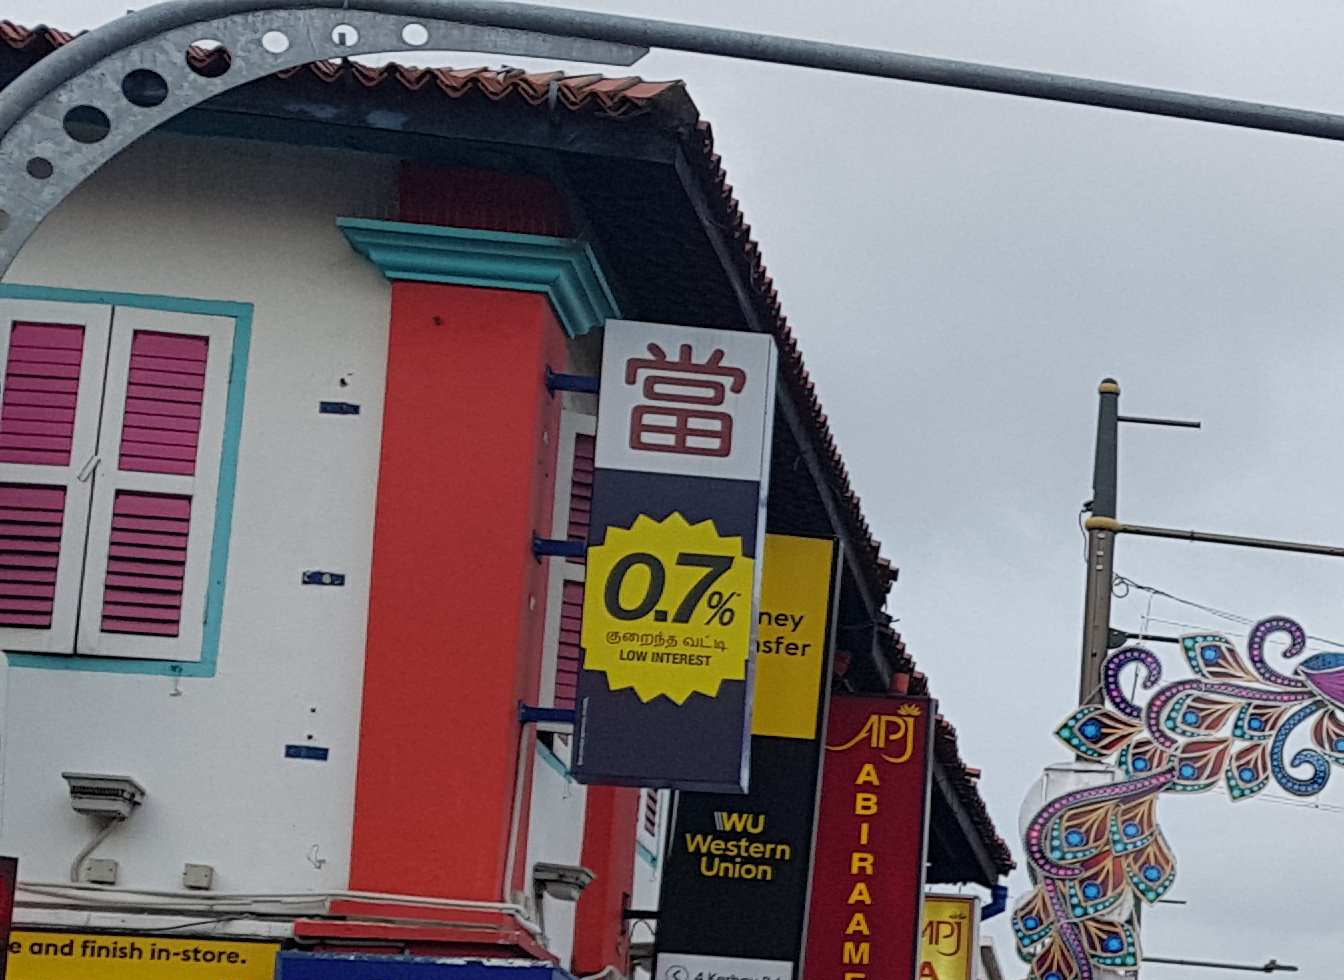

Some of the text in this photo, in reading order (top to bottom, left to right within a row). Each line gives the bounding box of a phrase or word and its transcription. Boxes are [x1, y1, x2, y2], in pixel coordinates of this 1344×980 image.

[624, 342, 747, 458] 當
[603, 551, 737, 626] 0.7%
[758, 610, 804, 639] ney
[682, 634, 728, 652] வட்டி
[757, 637, 812, 657] sfer
[619, 649, 712, 667] LOW INTEREST
[714, 810, 766, 834] WU
[685, 832, 791, 861] Western
[700, 857, 773, 880] Union
[29, 939, 74, 958] and
[80, 940, 144, 961] finish
[150, 942, 248, 965] in-store.
